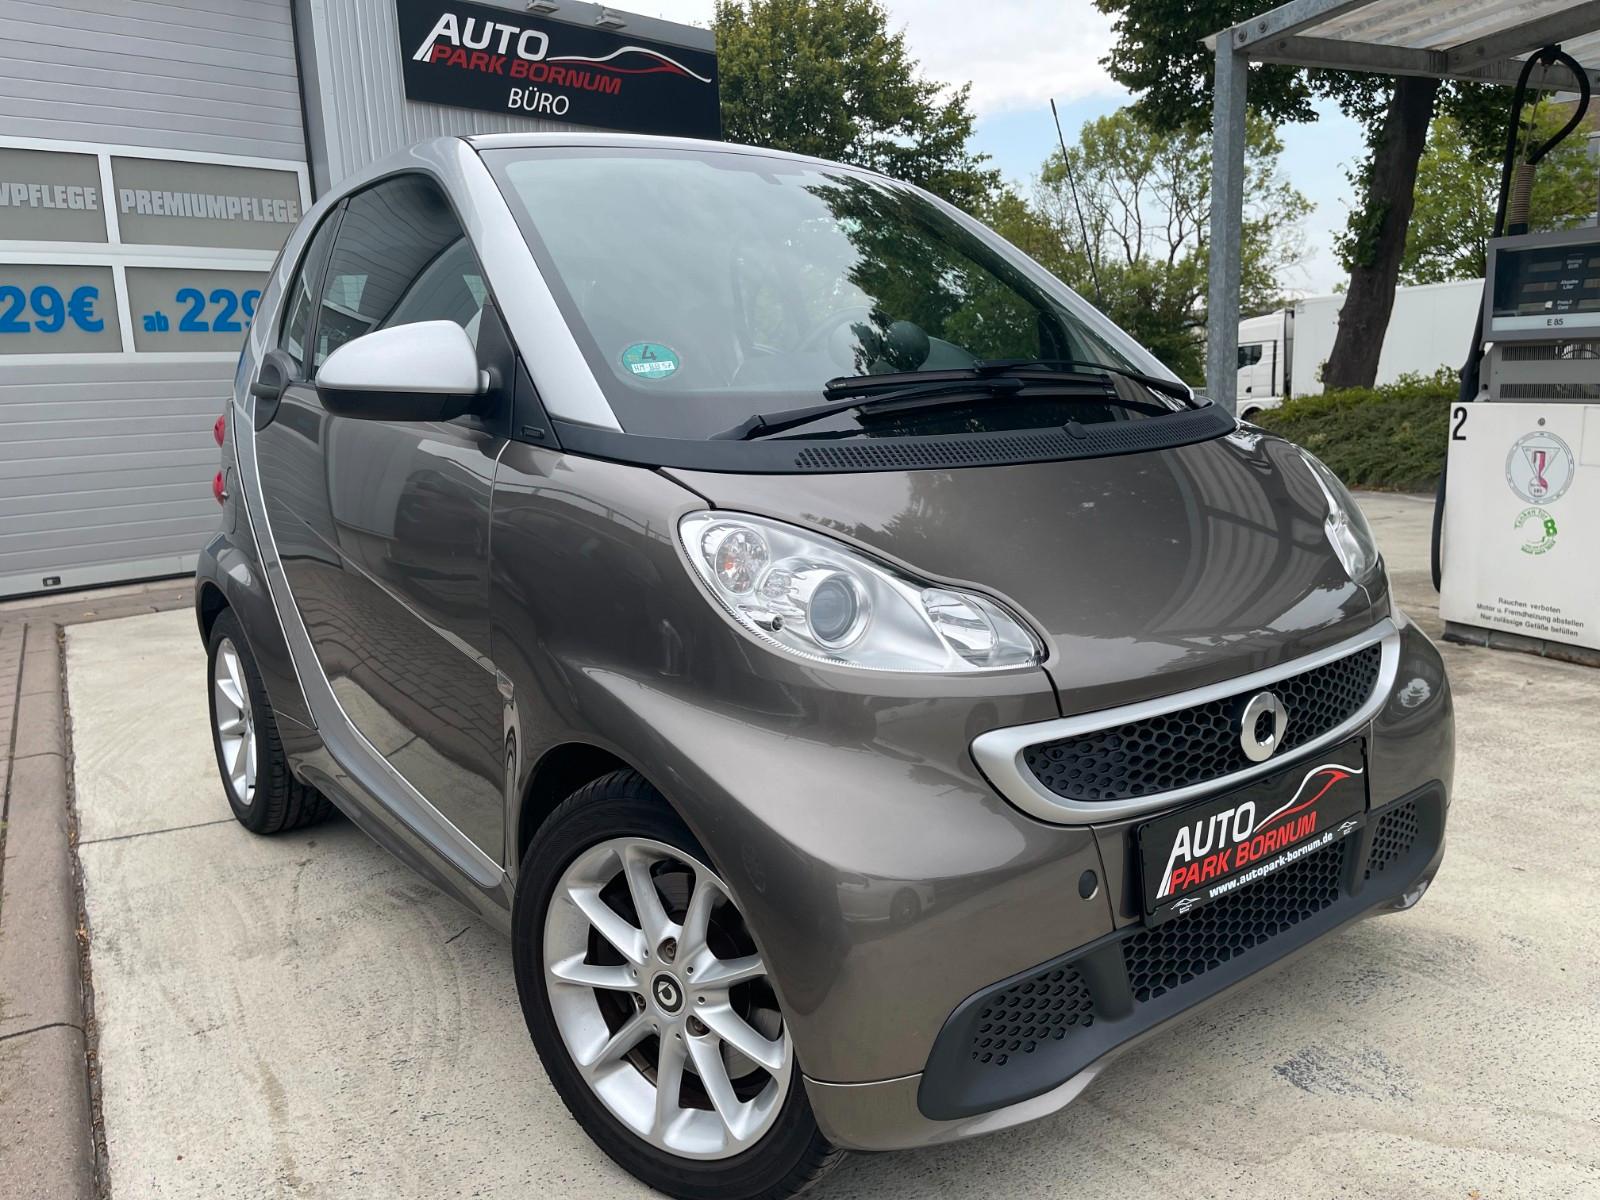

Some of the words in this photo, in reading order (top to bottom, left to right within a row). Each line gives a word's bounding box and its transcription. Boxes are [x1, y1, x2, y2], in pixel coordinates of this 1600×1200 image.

[412, 13, 550, 62] AUTO
[430, 44, 504, 75] PARK
[510, 59, 622, 95] BORNUM
[508, 87, 569, 115] BÜRO
[119, 188, 298, 223] PREMIUMPFLEGE
[143, 311, 169, 332] ab
[642, 345, 656, 360] 4
[1452, 407, 1468, 441] 2
[1498, 597, 1527, 608] Rauchen
[1530, 604, 1561, 614] verboten
[1156, 801, 1256, 899] AUTO
[1169, 848, 1232, 894] PARK
[1235, 811, 1317, 868] BORNUM
[1209, 831, 1333, 898] www.autopark-bornum.de
